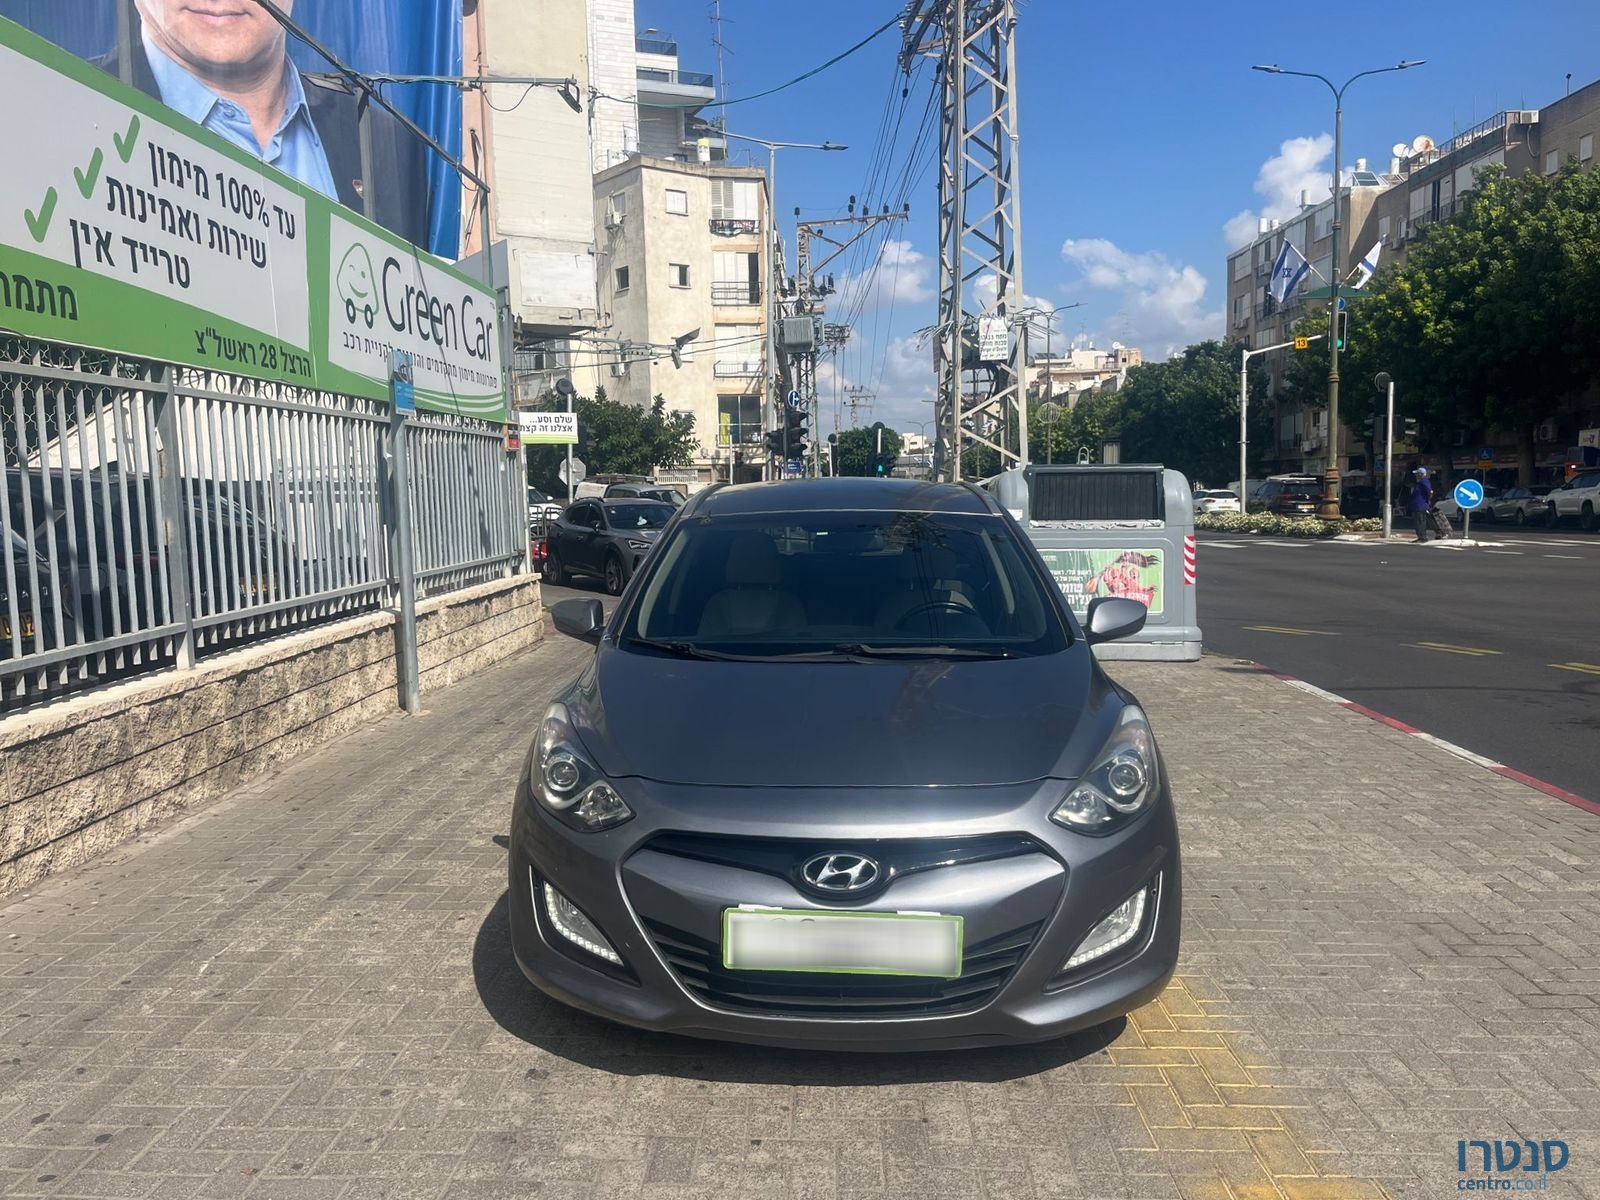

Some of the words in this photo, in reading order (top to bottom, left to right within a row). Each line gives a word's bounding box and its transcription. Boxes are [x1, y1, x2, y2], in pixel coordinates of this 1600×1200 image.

[148, 141, 210, 201] מימון
[106, 175, 202, 245] ואמינות
[216, 172, 270, 228] 100%
[272, 205, 296, 240] עד
[69, 219, 115, 268] אין
[207, 219, 267, 268] שירות
[122, 235, 190, 289] טרייד
[382, 256, 458, 350] Green
[461, 295, 493, 362] Car
[259, 342, 277, 369] 28
[343, 331, 361, 352] רכב
[1296, 339, 1306, 347] 13
[280, 346, 311, 378] הרצל
[520, 424, 537, 434] קצת
[539, 424, 549, 432] זה
[550, 424, 573, 433] אצלנו
[554, 415, 573, 424] שלם
